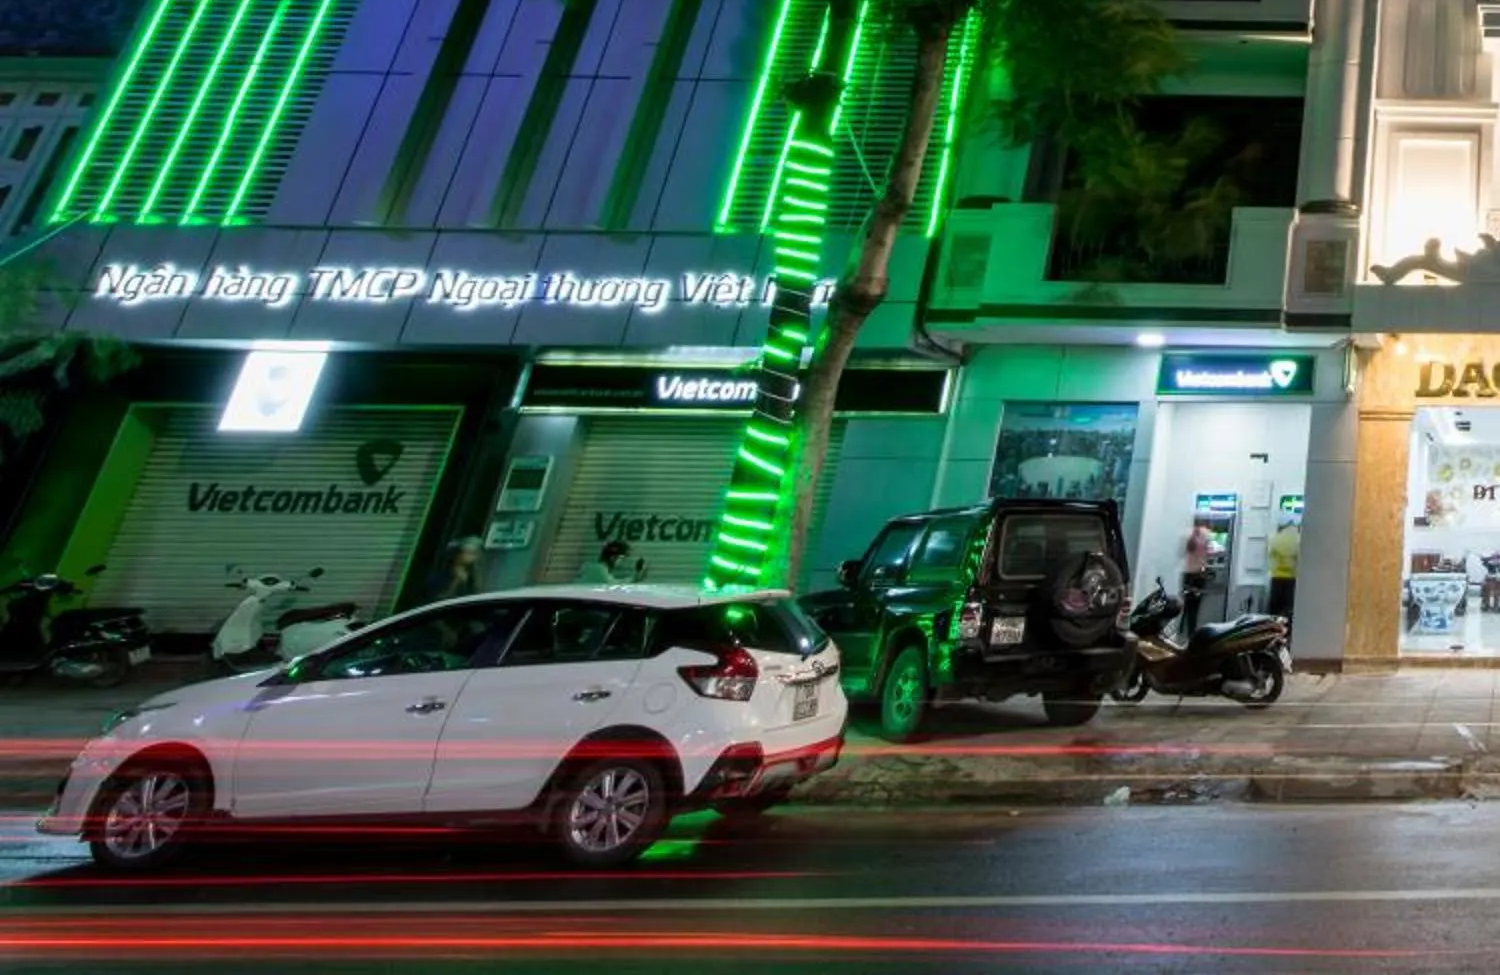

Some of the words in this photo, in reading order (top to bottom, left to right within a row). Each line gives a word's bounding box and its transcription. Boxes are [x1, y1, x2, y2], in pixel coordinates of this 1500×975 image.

[94, 262, 196, 306] Ngân
[201, 264, 298, 309] hàng
[307, 266, 424, 305] TMCP
[427, 270, 532, 312] Ngoại
[681, 272, 755, 313] Việt
[657, 375, 758, 401] Vietcom
[187, 482, 407, 515] Vietcombank
